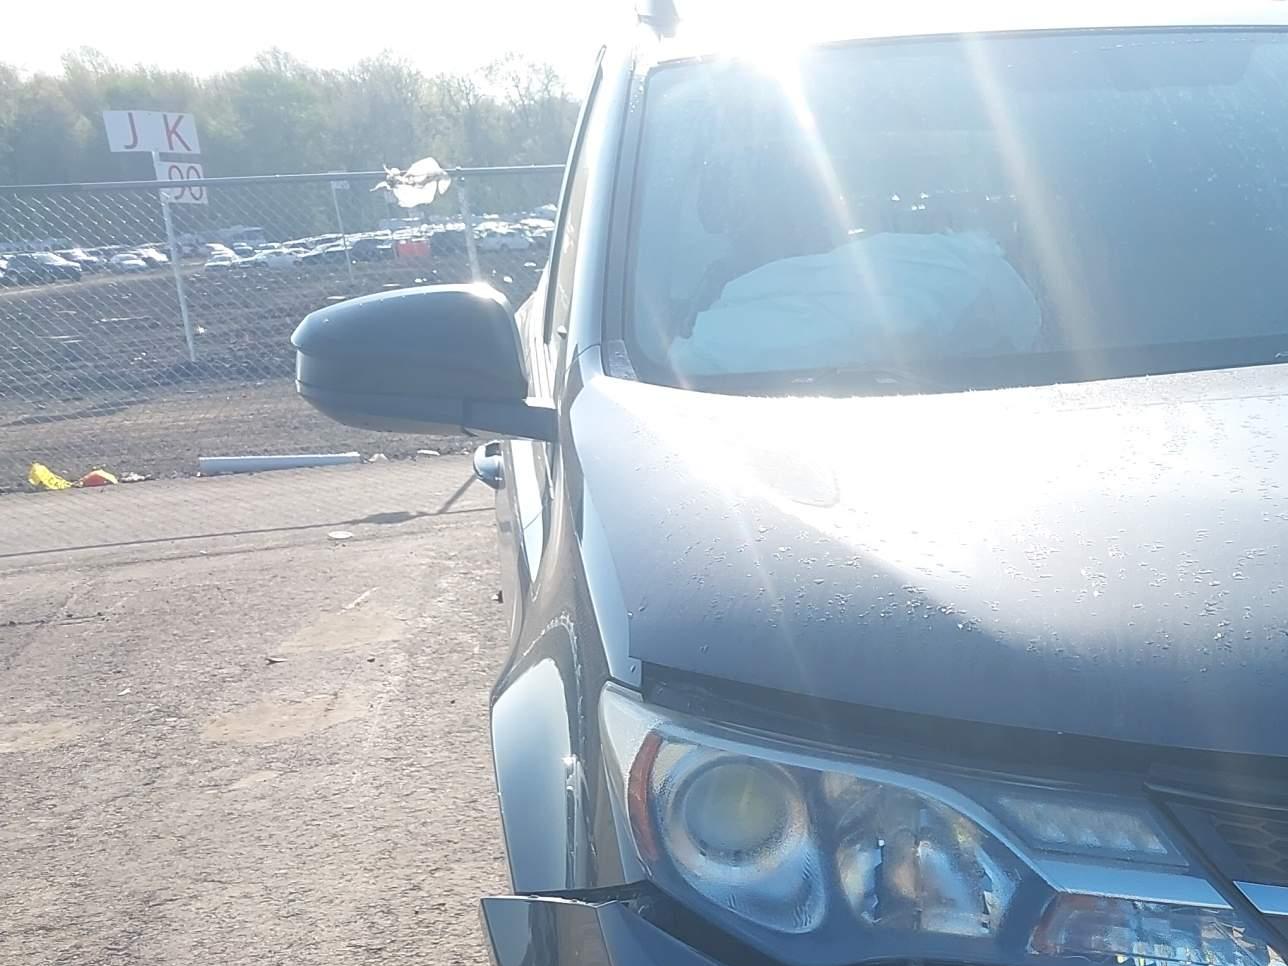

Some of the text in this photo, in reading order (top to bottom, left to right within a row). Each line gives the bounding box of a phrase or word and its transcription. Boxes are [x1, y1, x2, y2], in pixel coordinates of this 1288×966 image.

[124, 112, 192, 151] J K
[168, 165, 204, 200] 90
